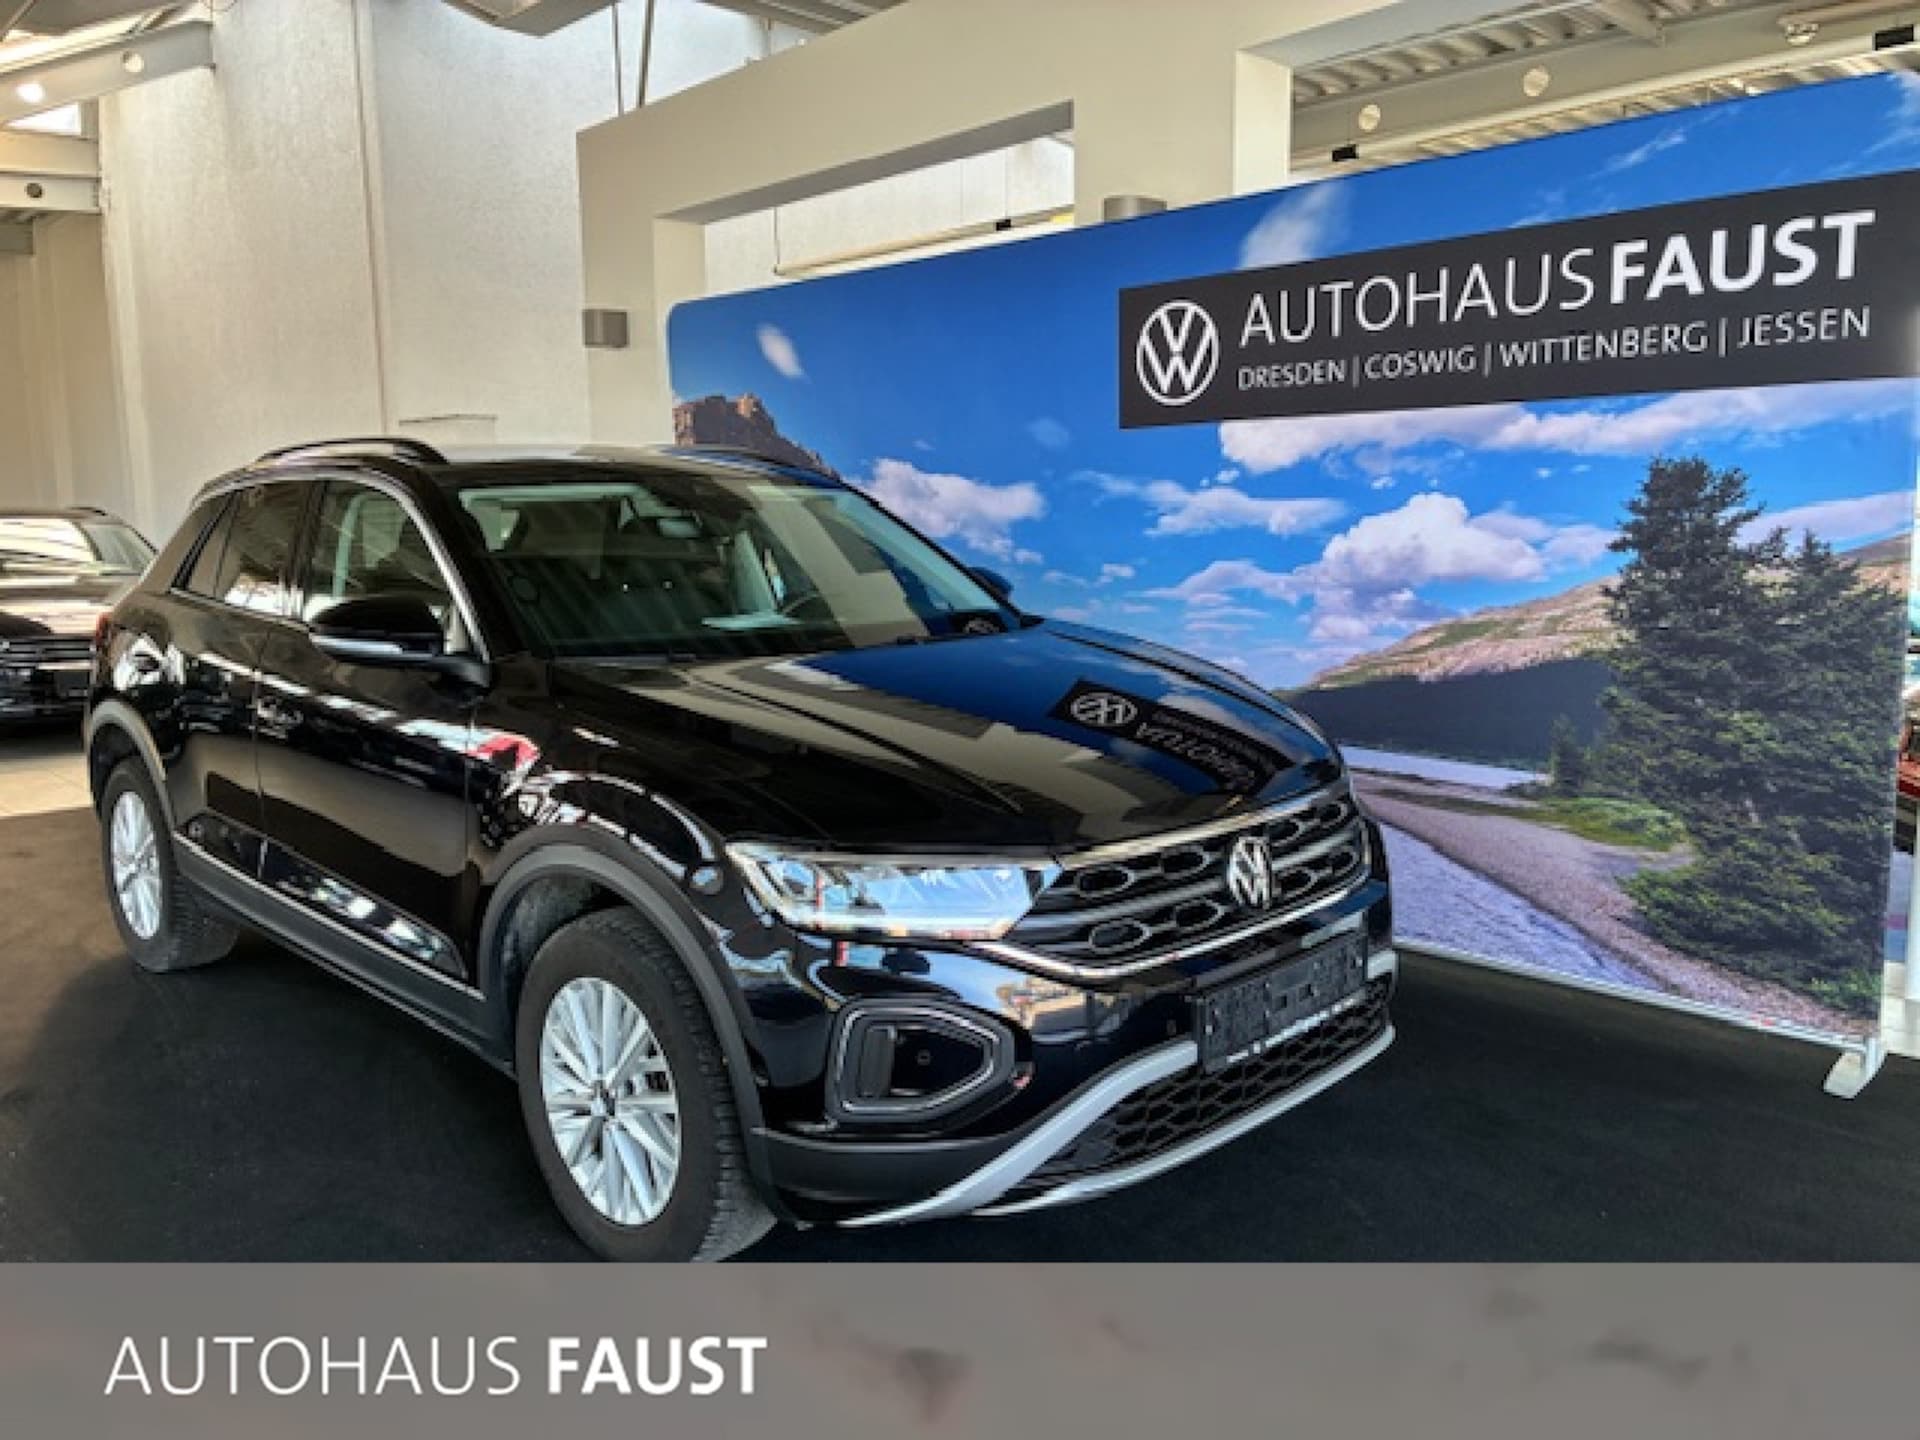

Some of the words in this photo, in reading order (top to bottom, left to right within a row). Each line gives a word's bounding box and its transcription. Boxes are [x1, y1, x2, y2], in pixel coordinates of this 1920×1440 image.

[1240, 248, 1594, 347] AUTOHAUS
[1611, 211, 1875, 304] FAUST
[1238, 358, 1346, 390] DRESDEN
[1364, 346, 1477, 379] COSWIG
[1499, 322, 1708, 368] WITTENBERG
[1738, 306, 1871, 348] JESSEN
